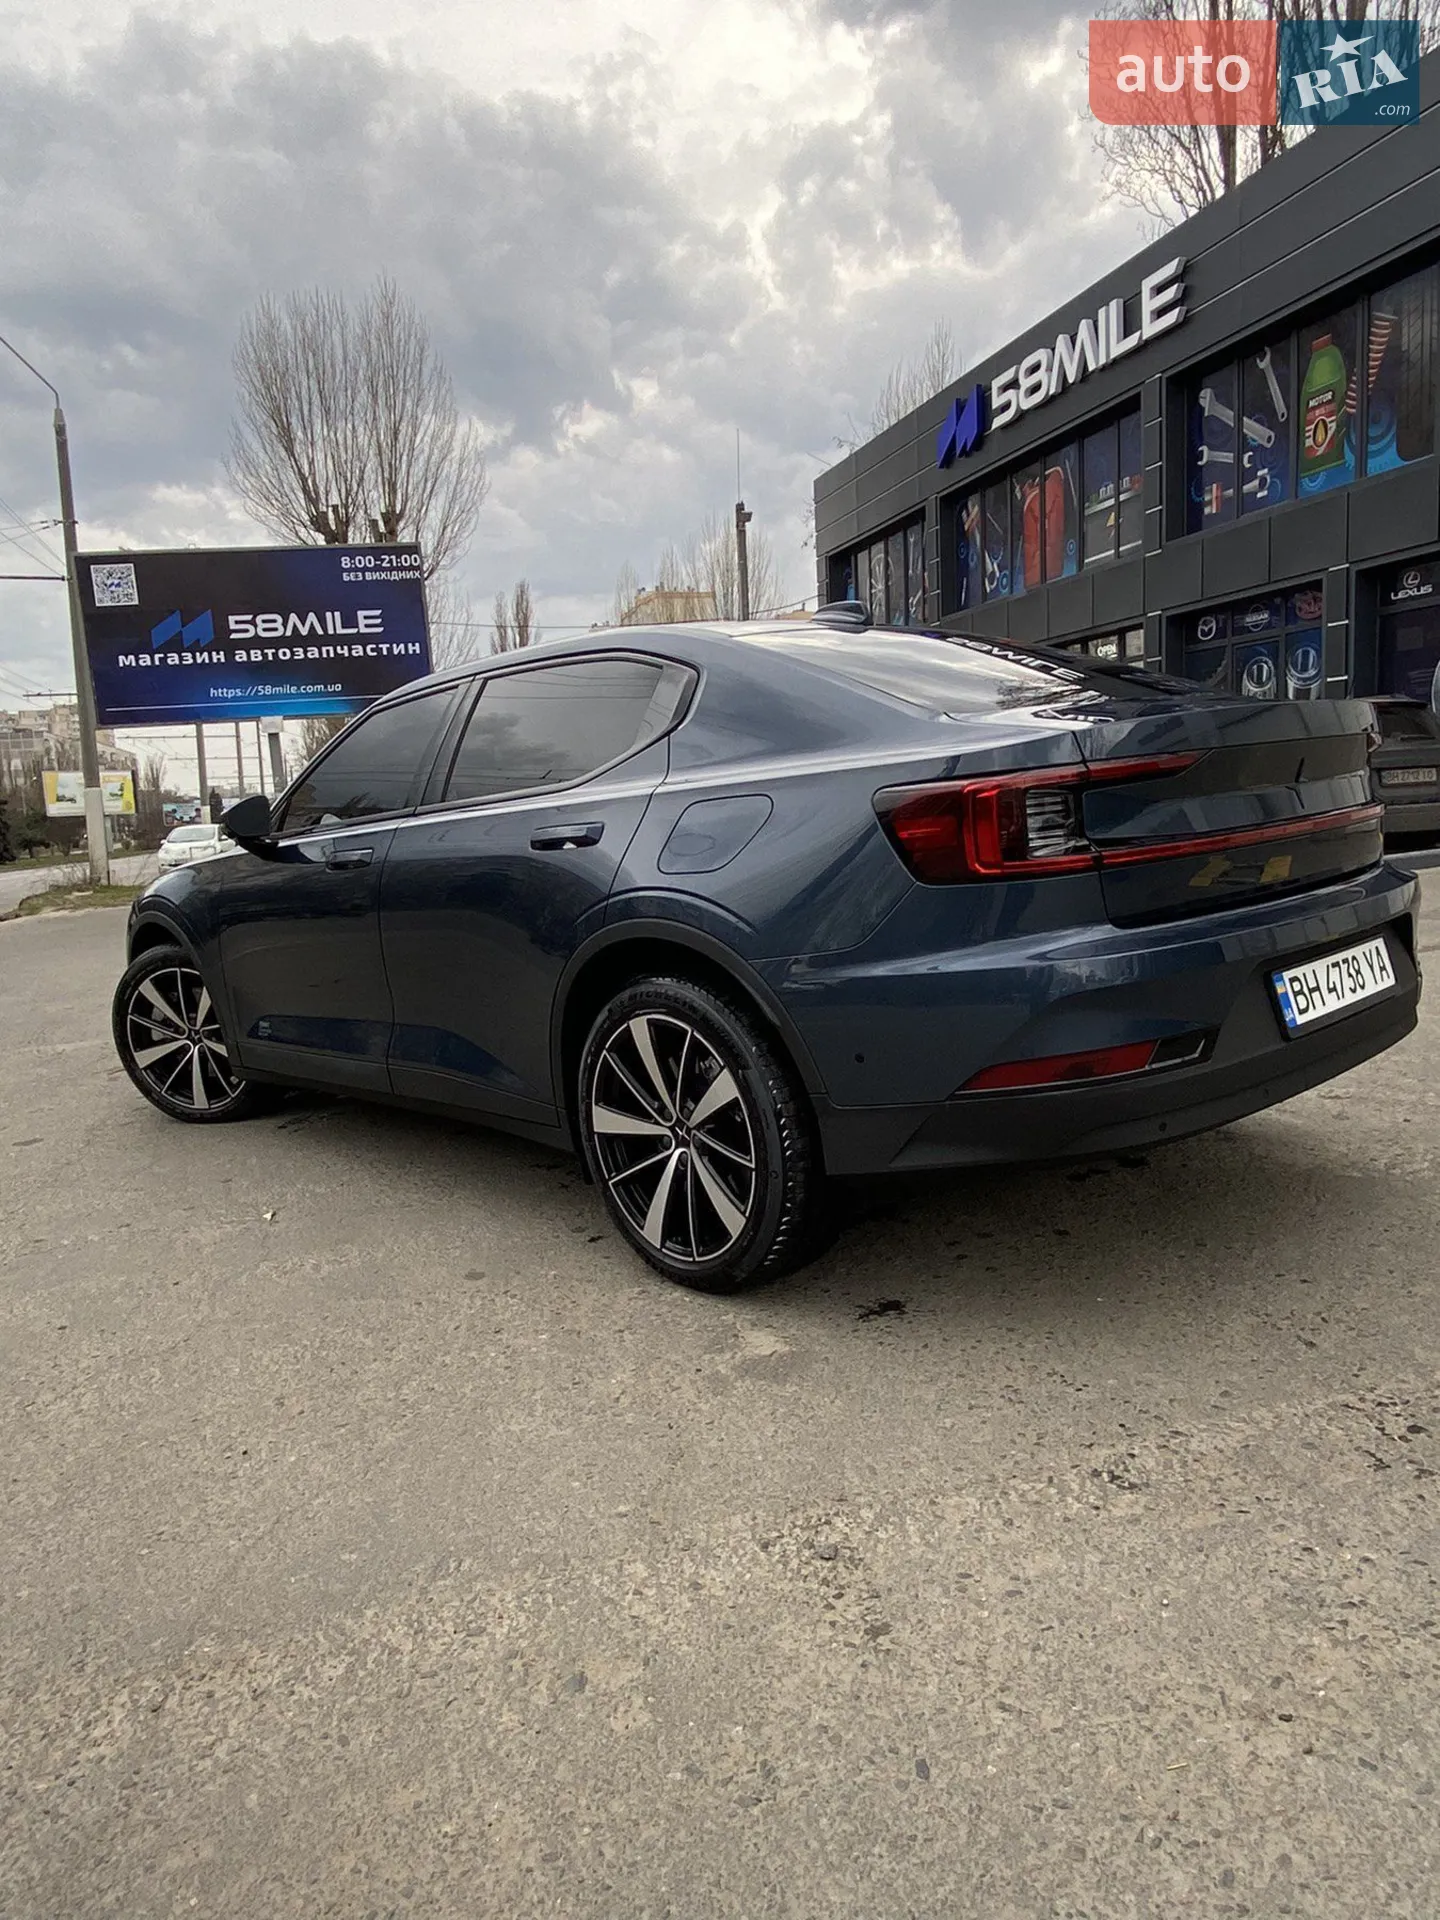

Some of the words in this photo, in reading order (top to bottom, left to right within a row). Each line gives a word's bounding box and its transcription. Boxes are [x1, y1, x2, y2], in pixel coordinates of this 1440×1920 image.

[991, 256, 1187, 430] 58MILE
[340, 554, 420, 569] 8:00-21:00
[342, 571, 363, 582] БЕЗ
[365, 570, 421, 581] ВИХІДНИХ
[1391, 584, 1433, 600] LEXUS
[228, 609, 384, 639] 58MILE
[118, 651, 225, 668] магазин
[234, 642, 421, 662] автозапчастин
[210, 682, 342, 699] https://58mile.com.ua
[1288, 969, 1326, 1016] BH
[1326, 955, 1365, 1001] 4738
[1363, 945, 1391, 985] YA
